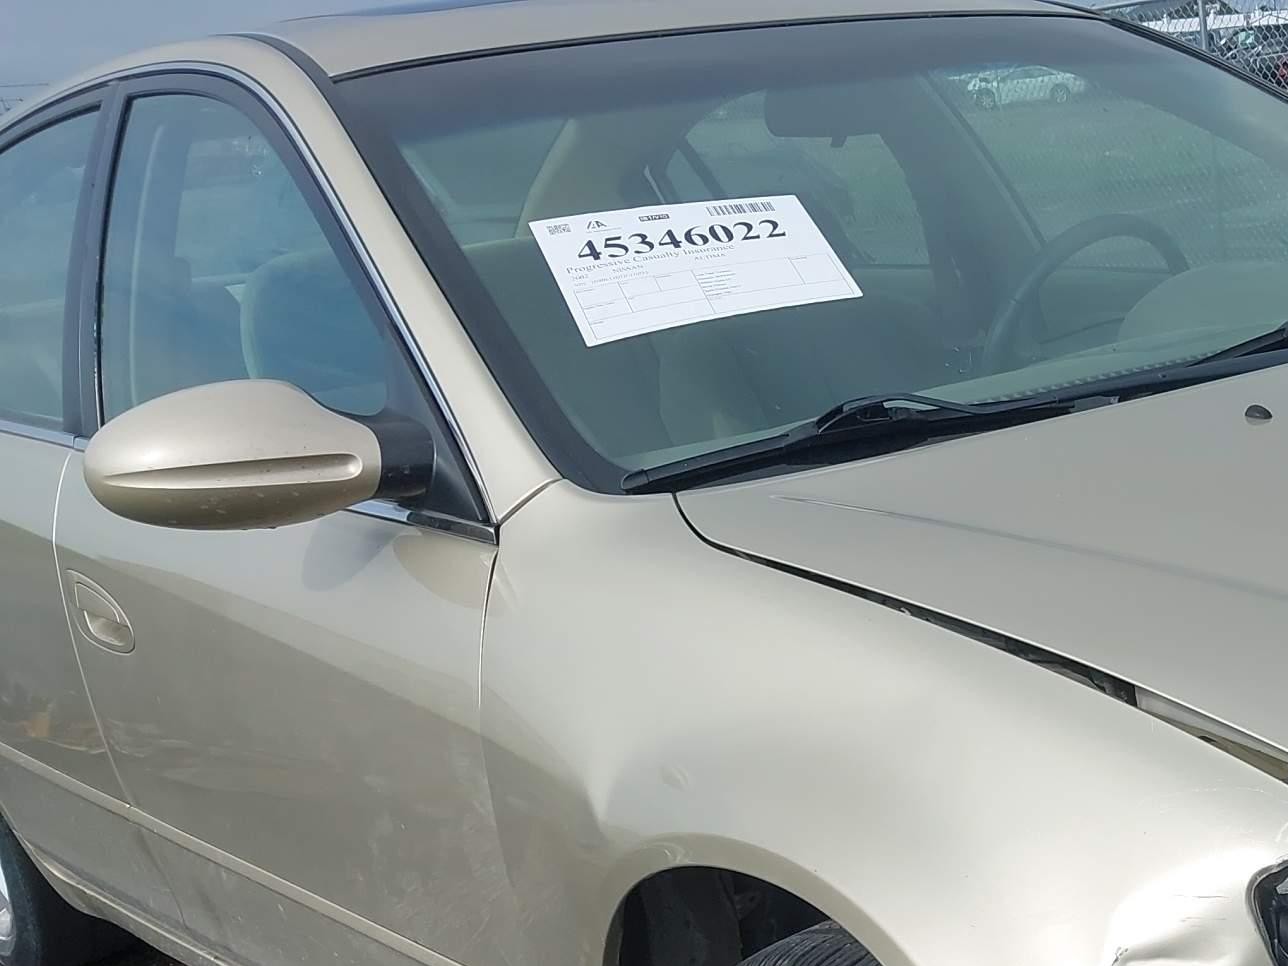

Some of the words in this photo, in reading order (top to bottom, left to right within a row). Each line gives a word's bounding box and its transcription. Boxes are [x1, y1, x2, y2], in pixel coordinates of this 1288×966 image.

[578, 219, 786, 260] 45346022
[566, 258, 631, 274] Progressive
[683, 244, 735, 255] Insurance
